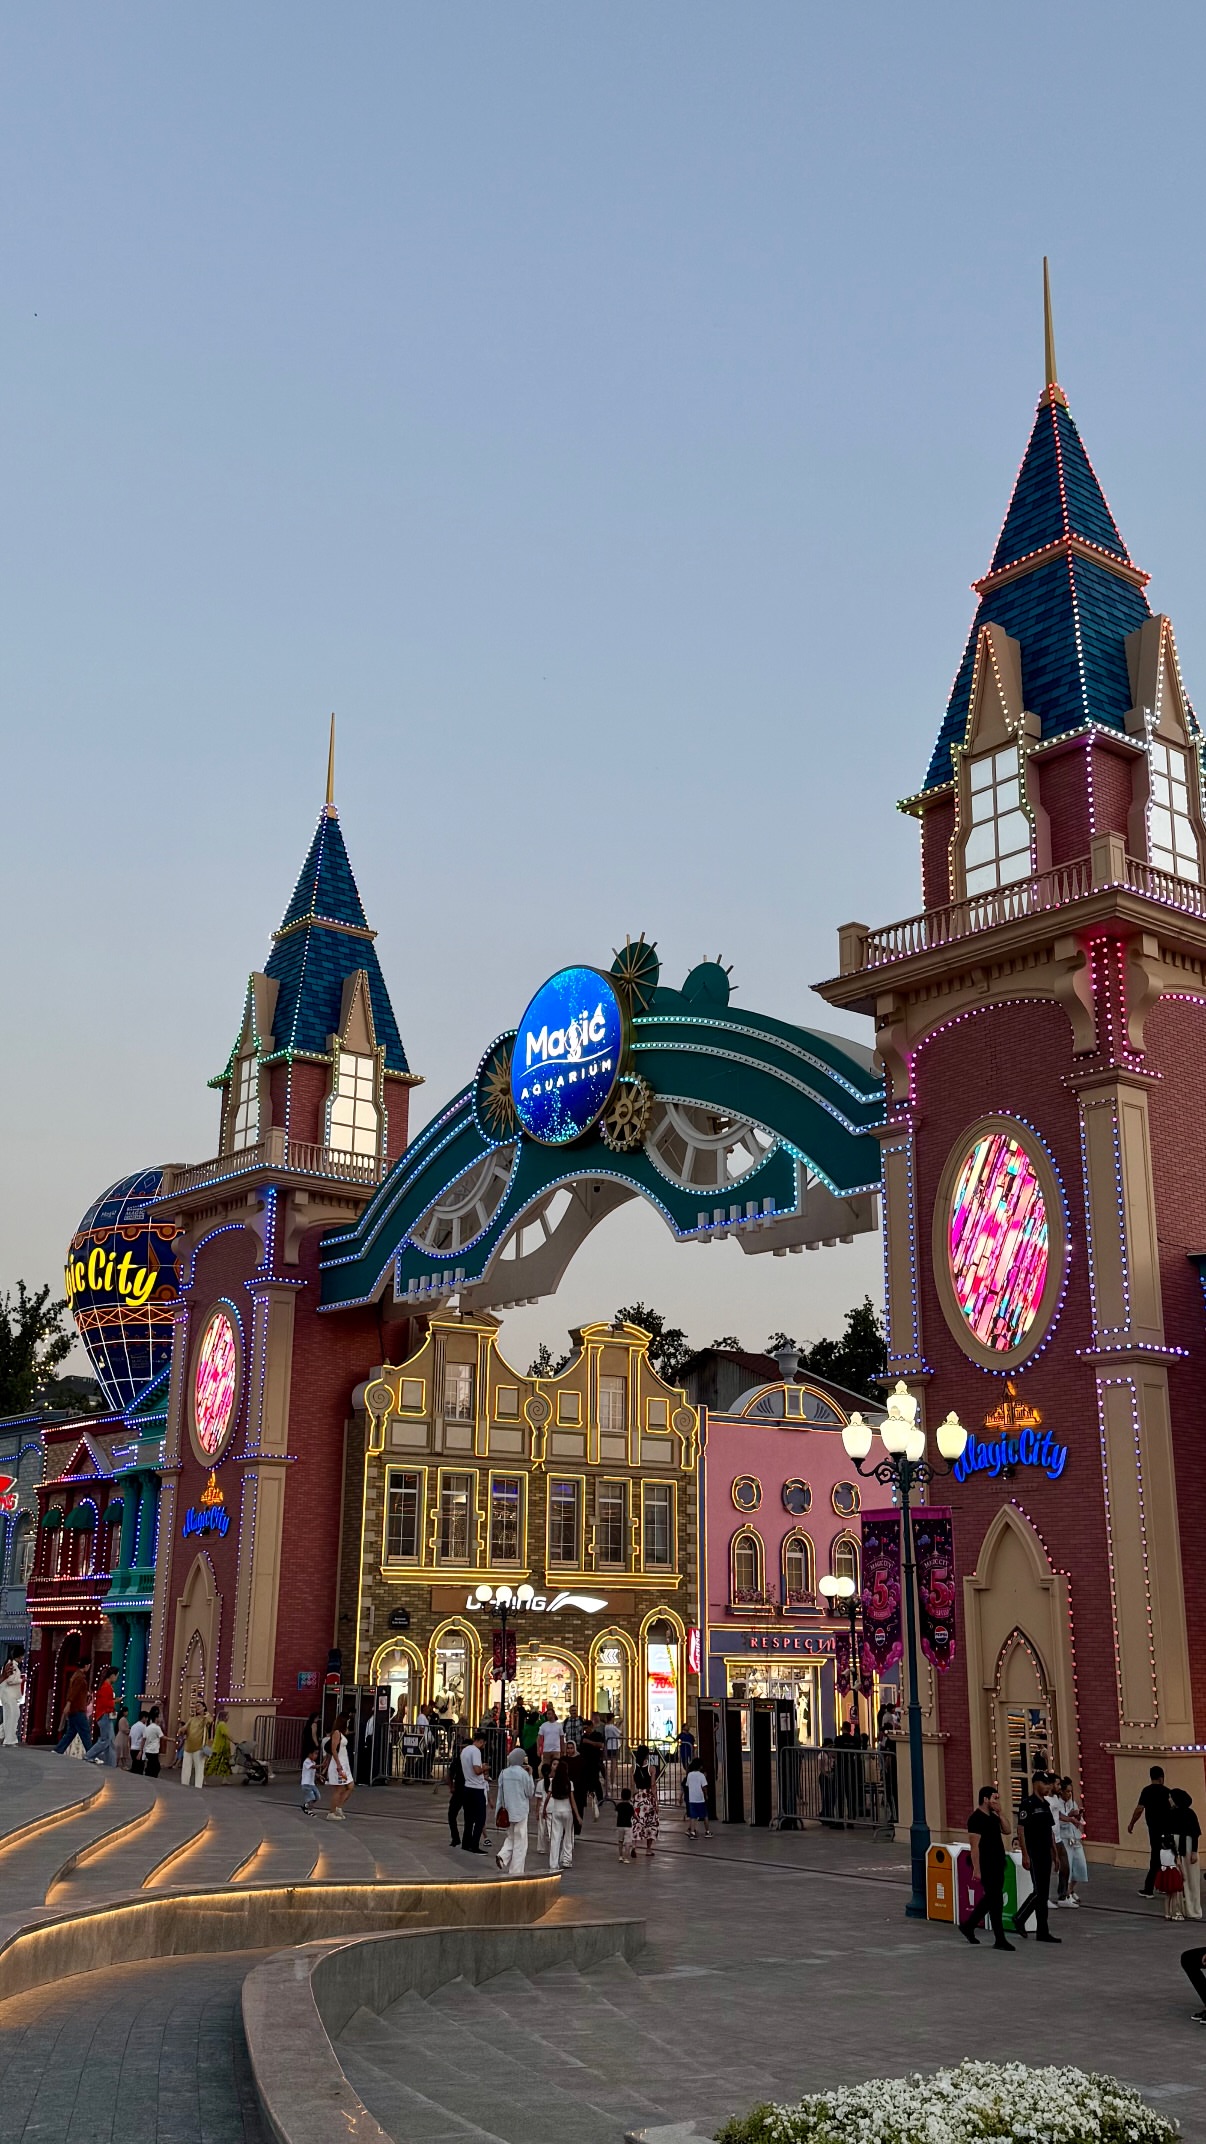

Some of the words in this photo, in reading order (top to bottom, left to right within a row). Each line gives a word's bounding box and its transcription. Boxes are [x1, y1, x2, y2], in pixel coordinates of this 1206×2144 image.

[526, 1003, 606, 1066] Magic
[521, 1059, 611, 1100] AQUARIUM
[87, 1247, 157, 1306] City
[872, 1570, 889, 1609] 5
[929, 1567, 950, 1608] 5
